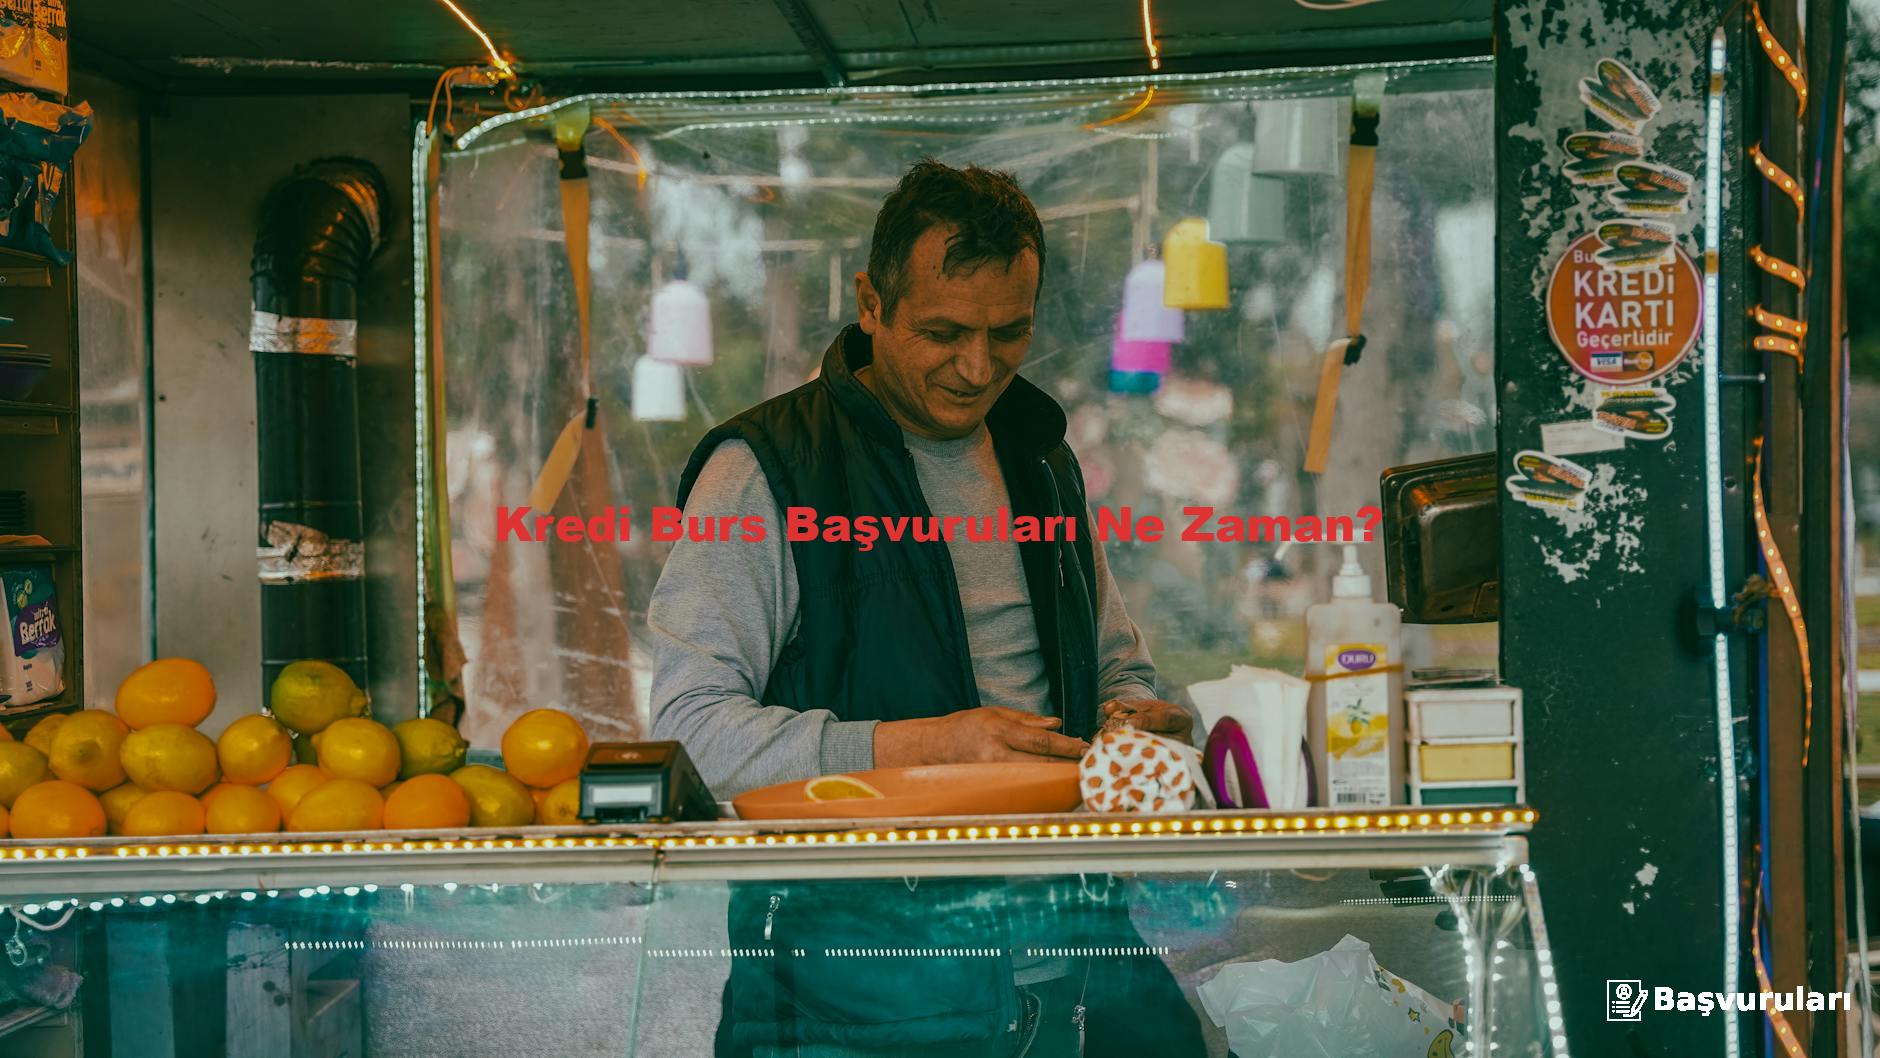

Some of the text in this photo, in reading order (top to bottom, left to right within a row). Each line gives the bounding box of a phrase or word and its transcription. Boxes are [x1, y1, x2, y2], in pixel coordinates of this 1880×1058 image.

[1573, 250, 1594, 264] Bu
[1575, 299, 1675, 329] KARTI
[1577, 329, 1673, 349] Geçerlidir
[20, 610, 57, 646] Berrak
